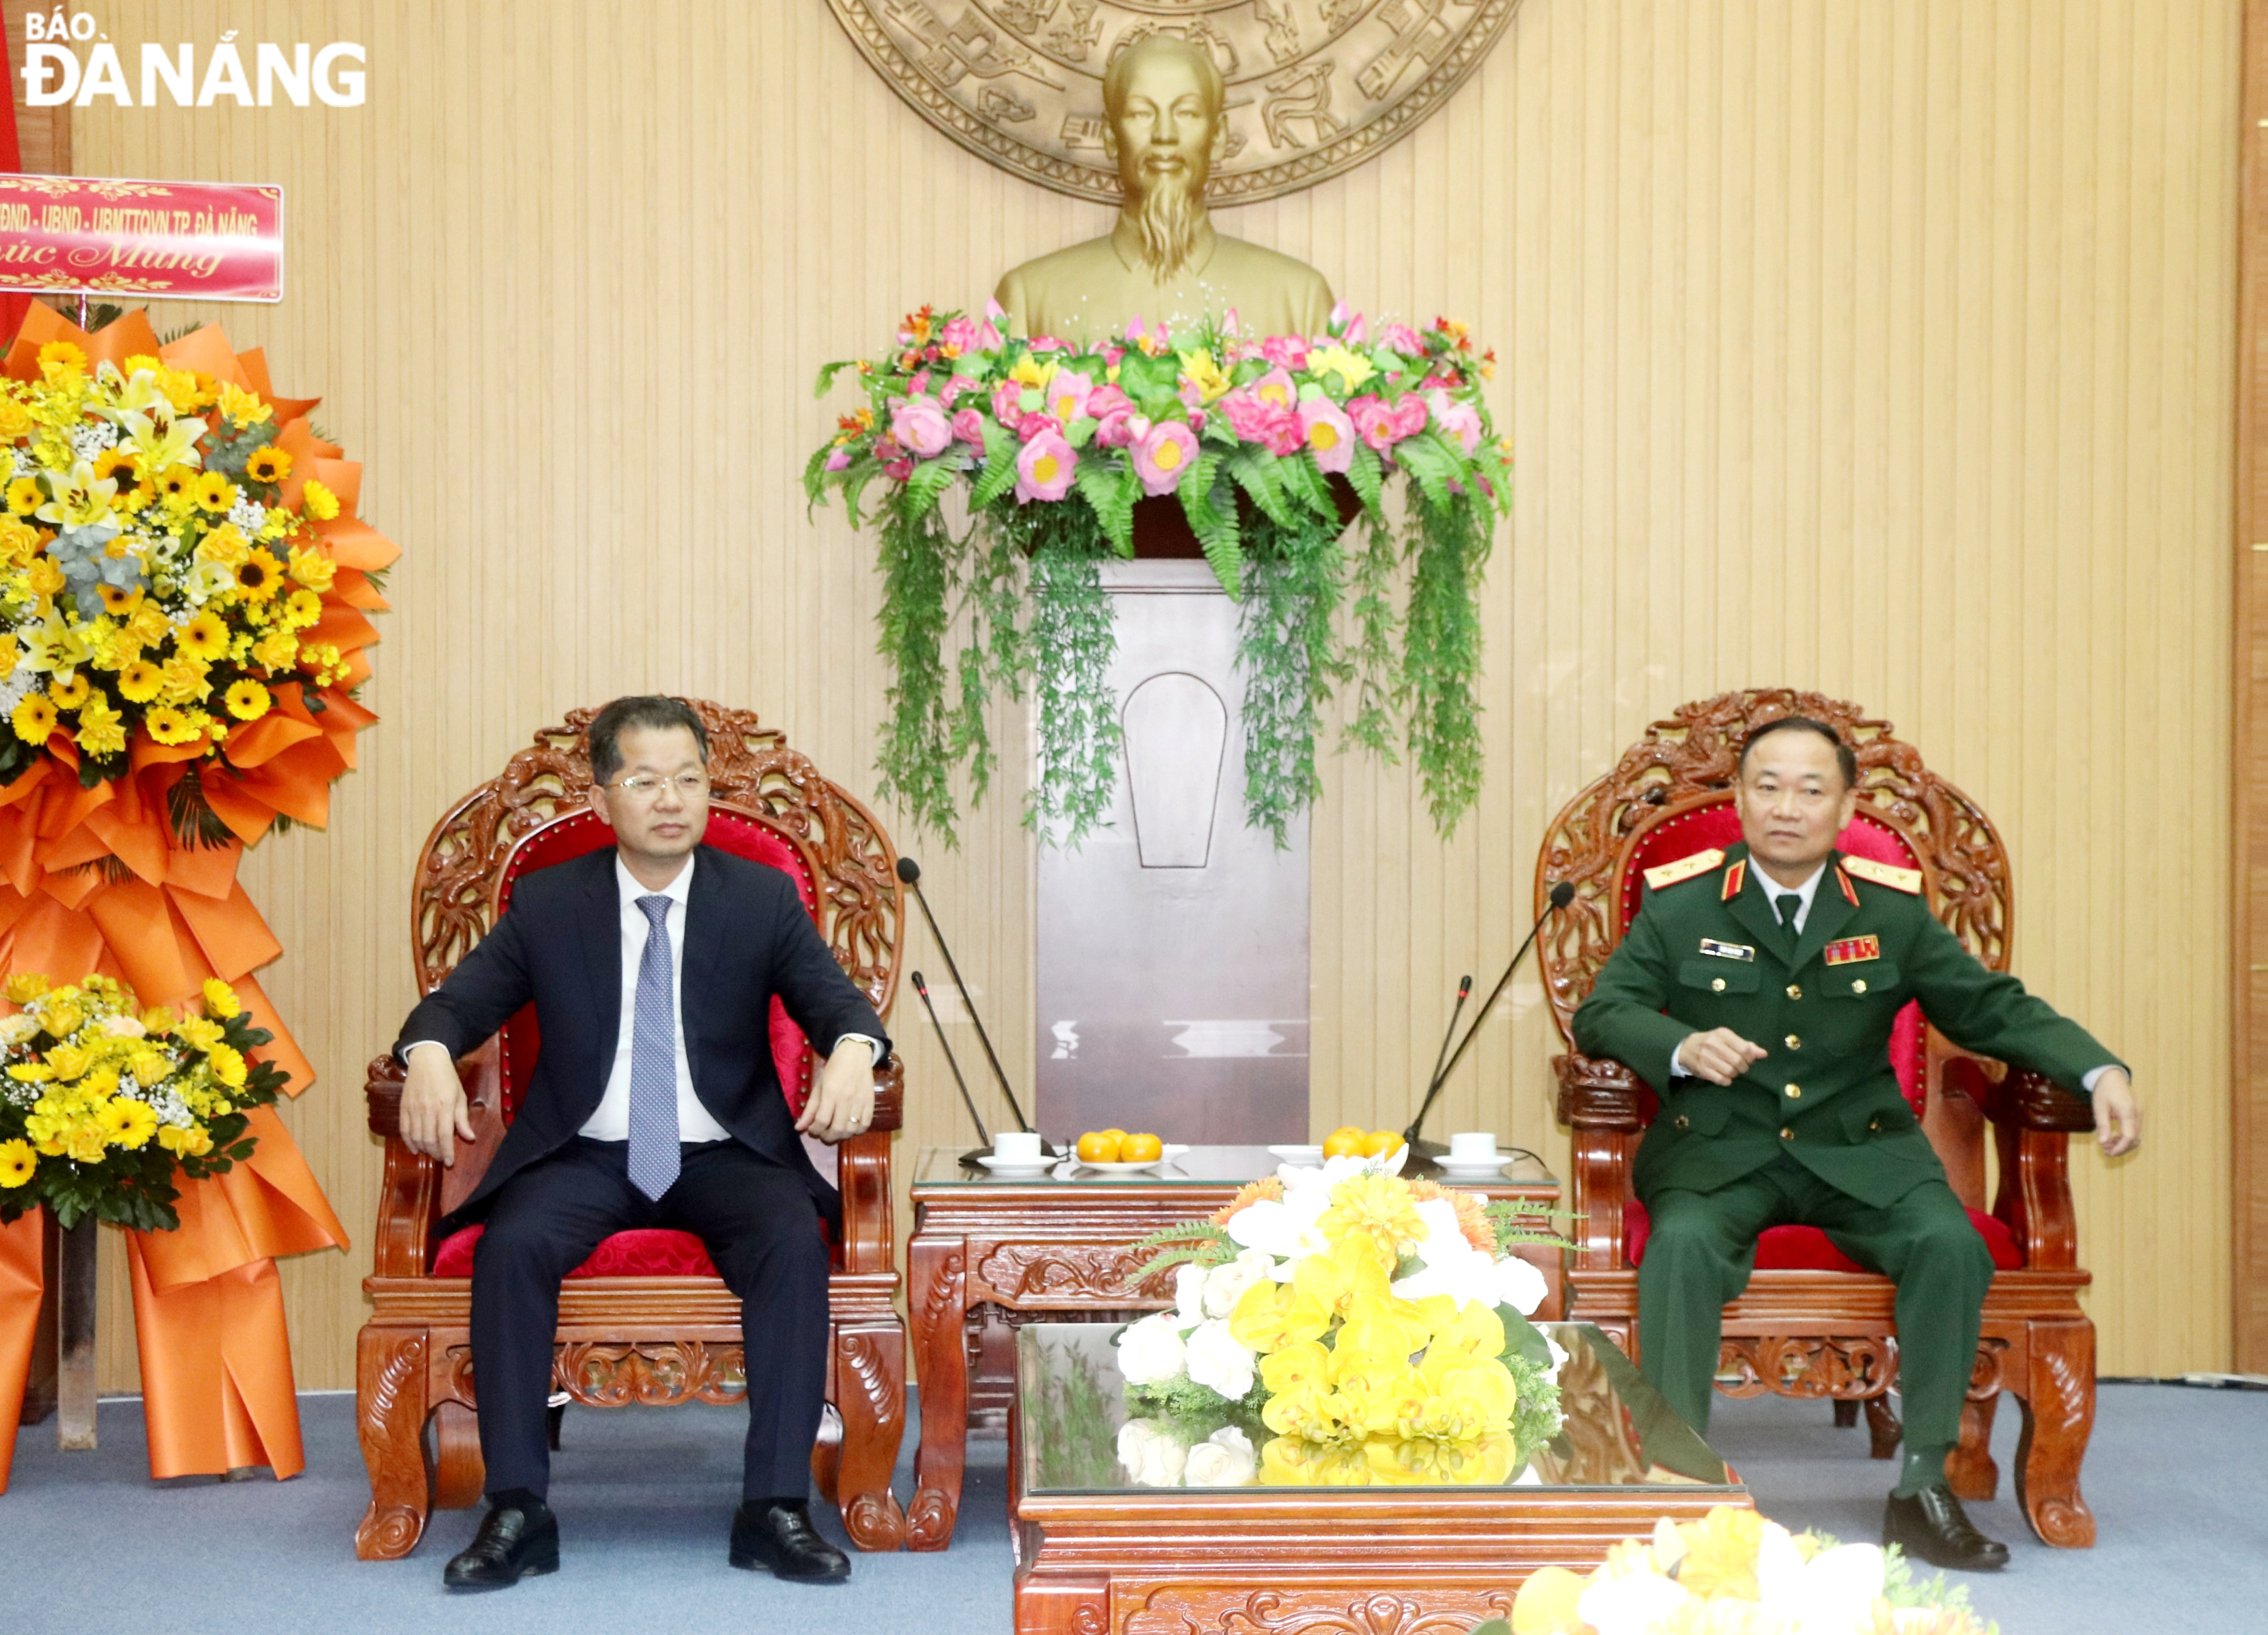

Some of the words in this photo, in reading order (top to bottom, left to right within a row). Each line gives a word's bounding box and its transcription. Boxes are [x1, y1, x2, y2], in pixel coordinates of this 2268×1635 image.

[0, 203, 31, 233] ĐND
[42, 204, 82, 234] UBND
[93, 207, 170, 238] UBMTTQVN
[195, 204, 214, 238] ĐÀ
[0, 239, 57, 264] úc
